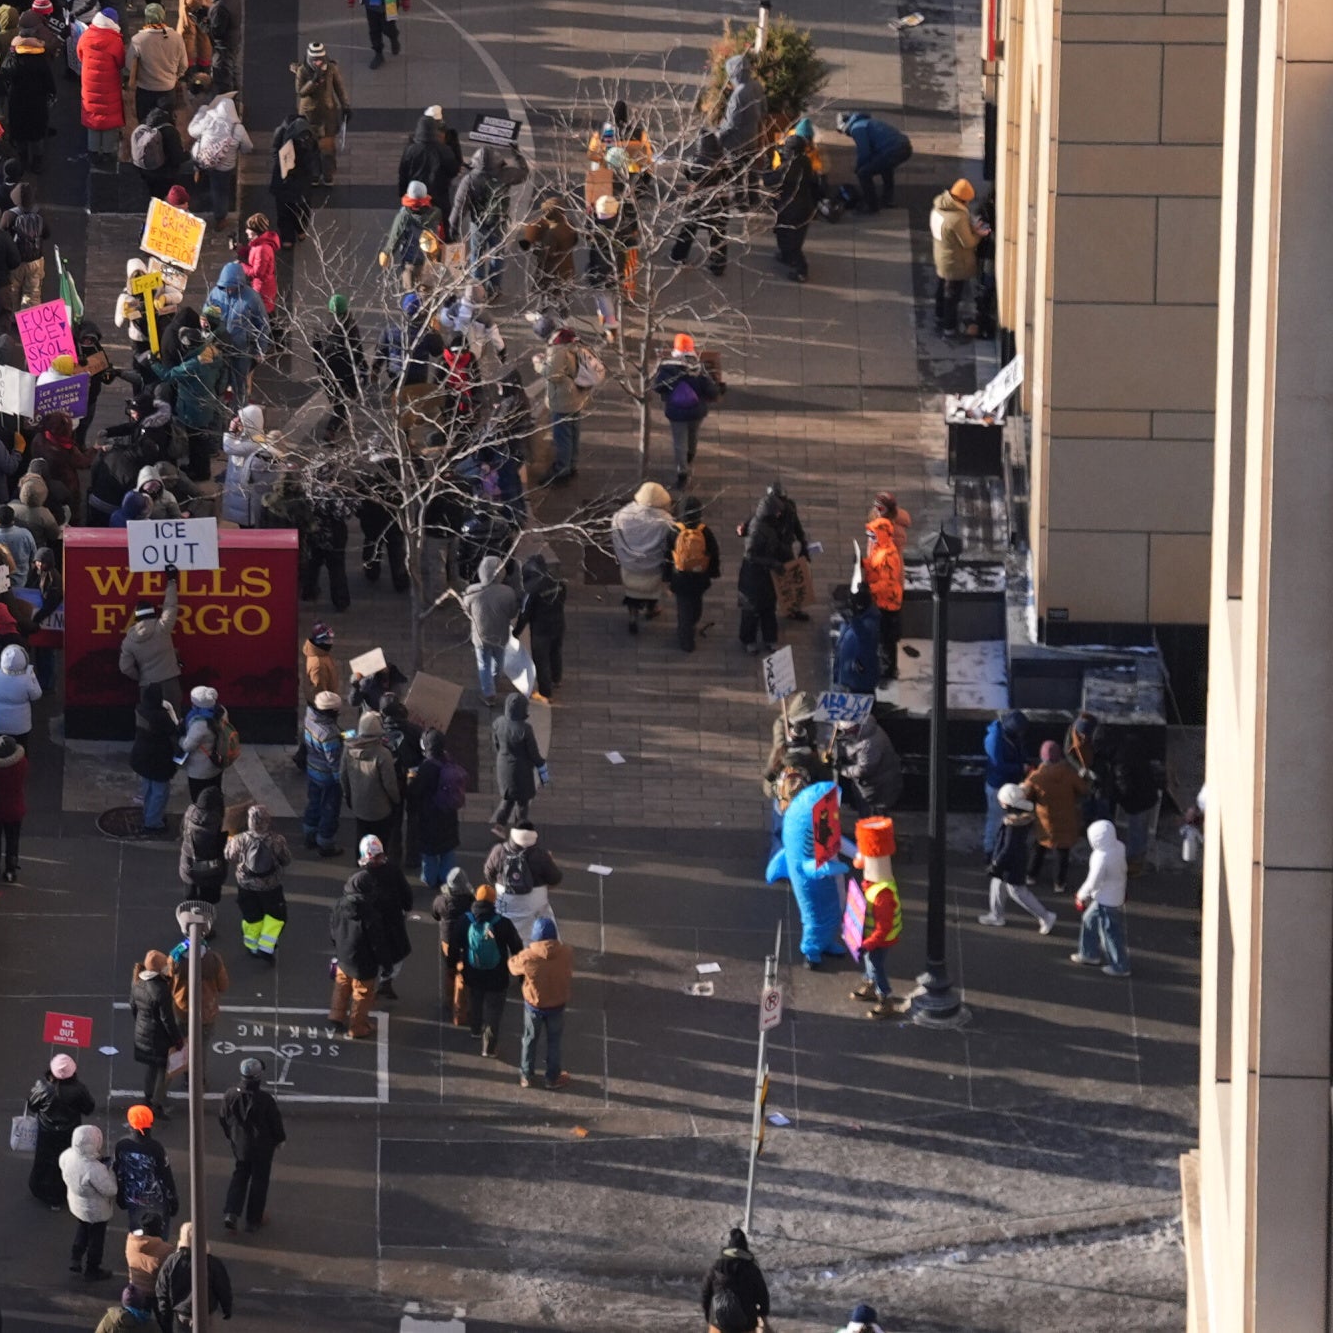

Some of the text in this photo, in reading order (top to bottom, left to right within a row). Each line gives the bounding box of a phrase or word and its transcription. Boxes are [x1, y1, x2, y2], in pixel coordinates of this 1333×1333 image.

[20, 305, 58, 331] FUCK
[27, 341, 66, 360] SKOL
[155, 523, 186, 539] ICE
[142, 543, 200, 565] OUT
[59, 1028, 75, 1037] OUT
[61, 1020, 74, 1028] ICE
